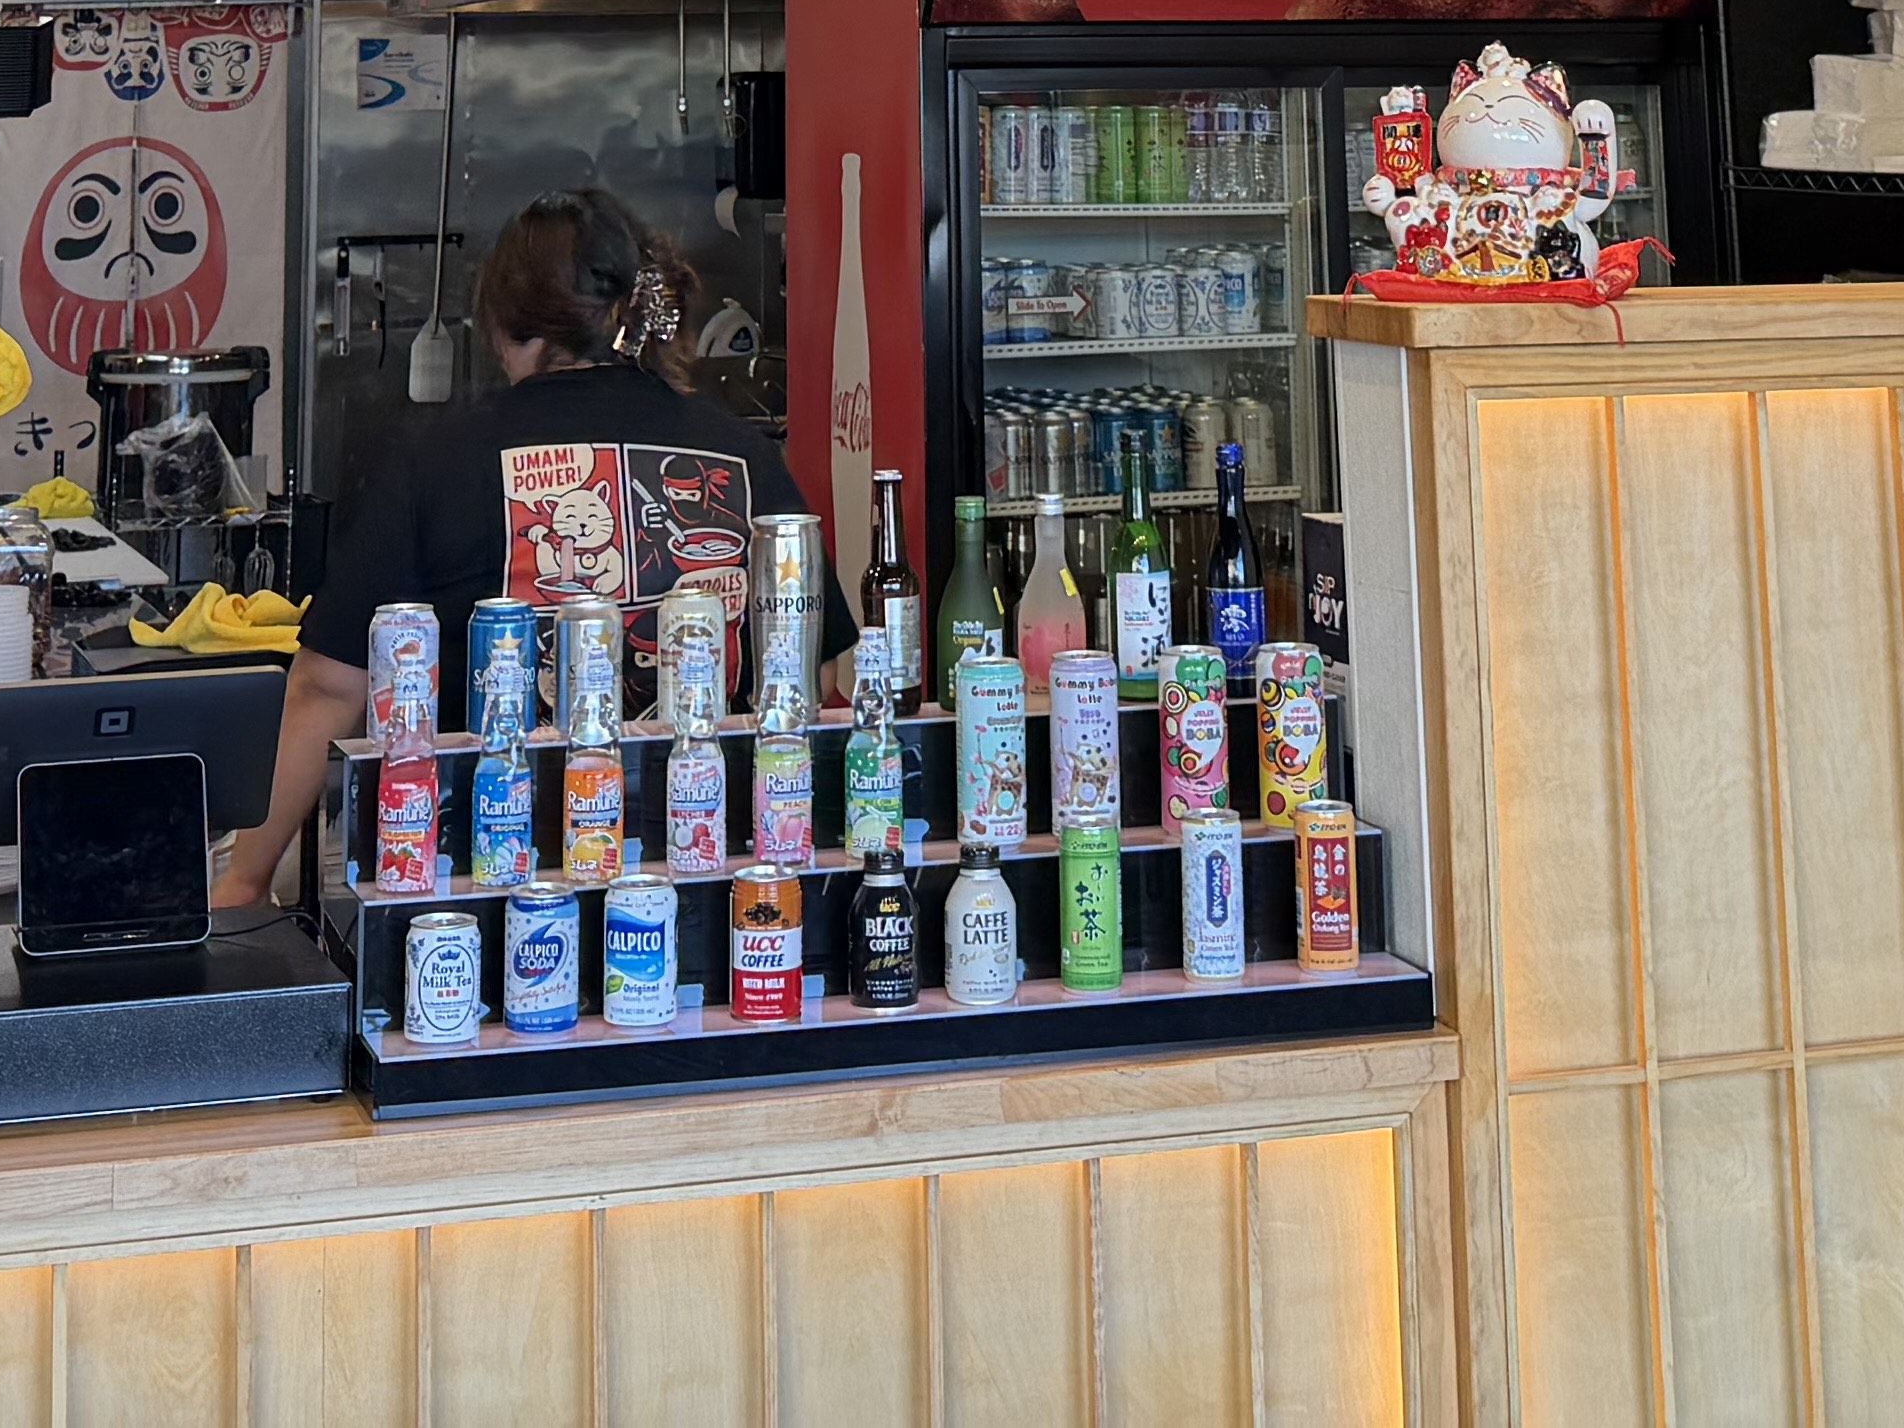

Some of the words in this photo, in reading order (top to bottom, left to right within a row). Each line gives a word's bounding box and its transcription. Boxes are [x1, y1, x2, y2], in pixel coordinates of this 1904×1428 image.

[513, 447, 575, 472] UMAMI
[513, 465, 583, 493] POWER!
[755, 596, 822, 614] SAPPORO
[1055, 677, 1095, 693] Gummy
[1185, 726, 1222, 742] BOBA
[1282, 723, 1319, 738] BOBA
[480, 795, 531, 816] Ramune
[568, 791, 621, 812] Ramune
[378, 800, 432, 823] Ramune
[1320, 823, 1335, 831] ITO
[1207, 833, 1222, 841] ITO
[963, 911, 1009, 929] CAFFE
[1074, 883, 1106, 941] お茶
[1311, 910, 1350, 925] Golden
[865, 916, 914, 937] BLACK
[607, 931, 662, 953] CALPICO
[742, 935, 786, 952] UCC
[869, 938, 911, 952] COFFEE
[963, 928, 1009, 945] LATTE
[518, 943, 560, 958] CALPICO
[518, 956, 557, 970] SODA
[741, 953, 785, 968] COFFEE
[431, 961, 465, 982] Royal
[422, 975, 453, 989] Milk
[455, 975, 472, 988] Tea
[622, 982, 661, 994] Original
